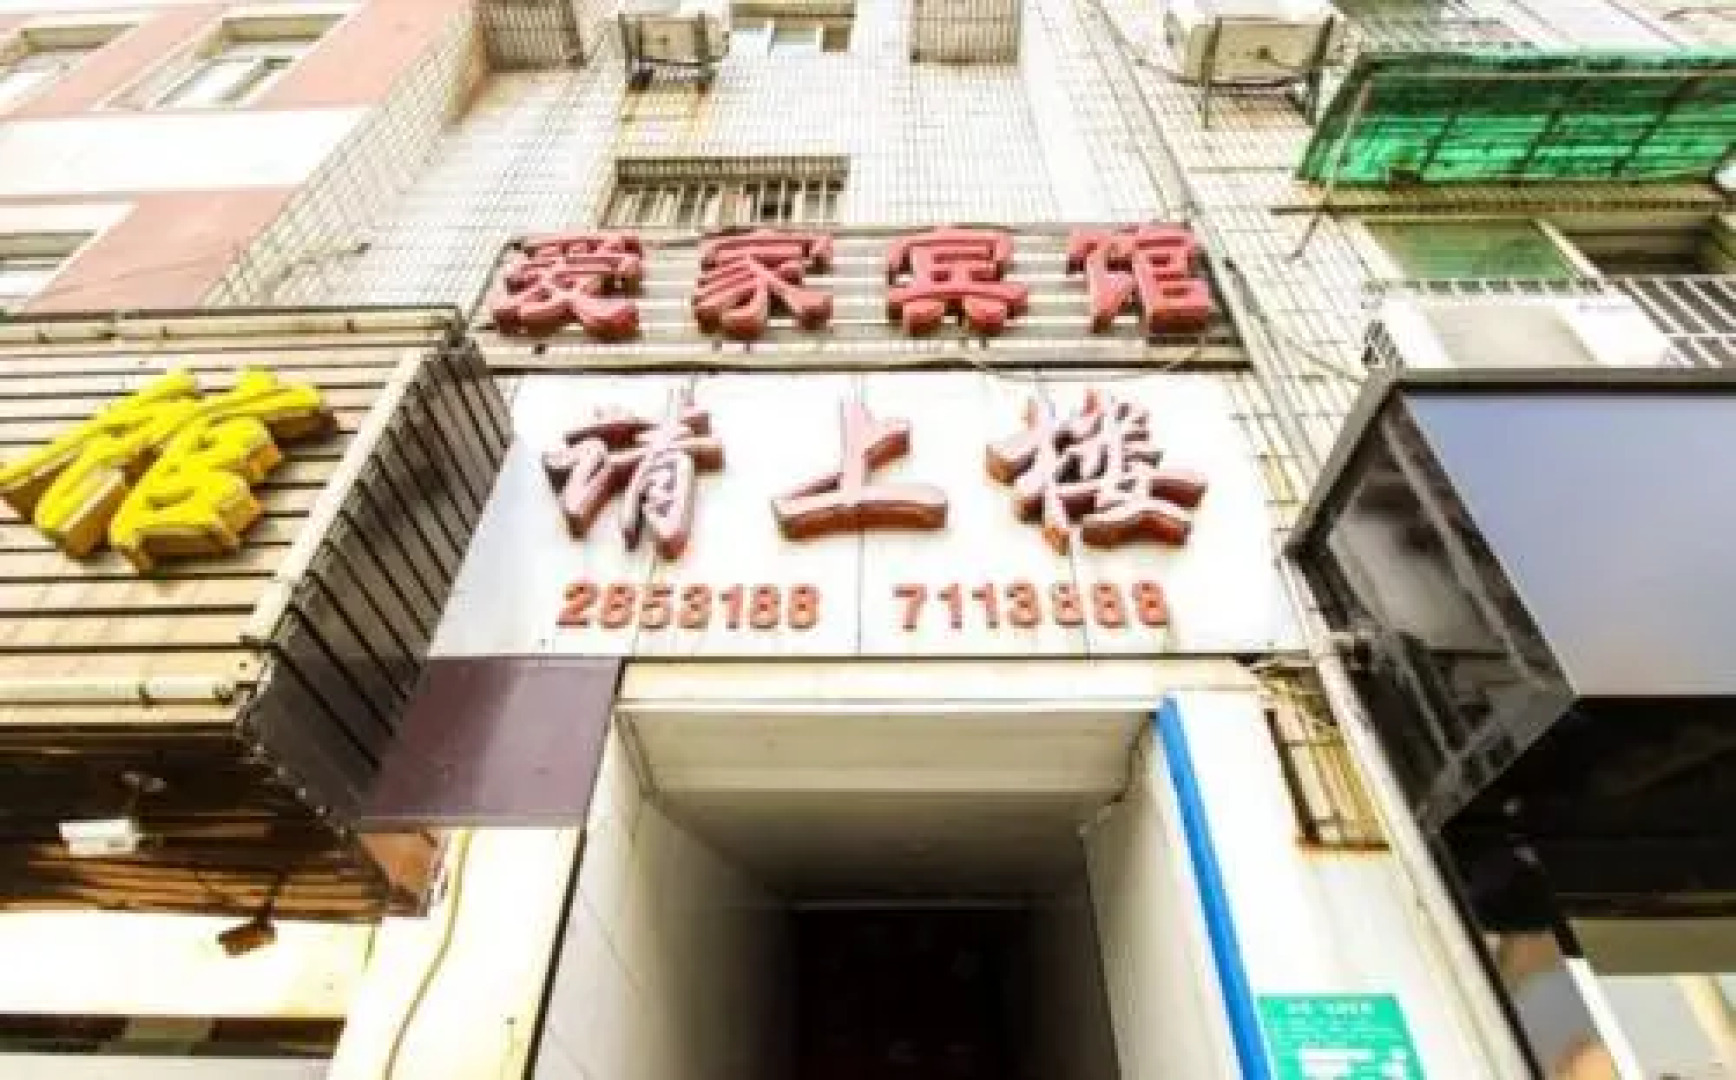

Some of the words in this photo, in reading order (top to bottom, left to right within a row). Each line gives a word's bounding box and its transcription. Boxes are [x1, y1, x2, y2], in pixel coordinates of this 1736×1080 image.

[489, 227, 1214, 339] 爱家宾馆
[543, 390, 1207, 559] 请上楼
[892, 580, 1169, 629] 7113888
